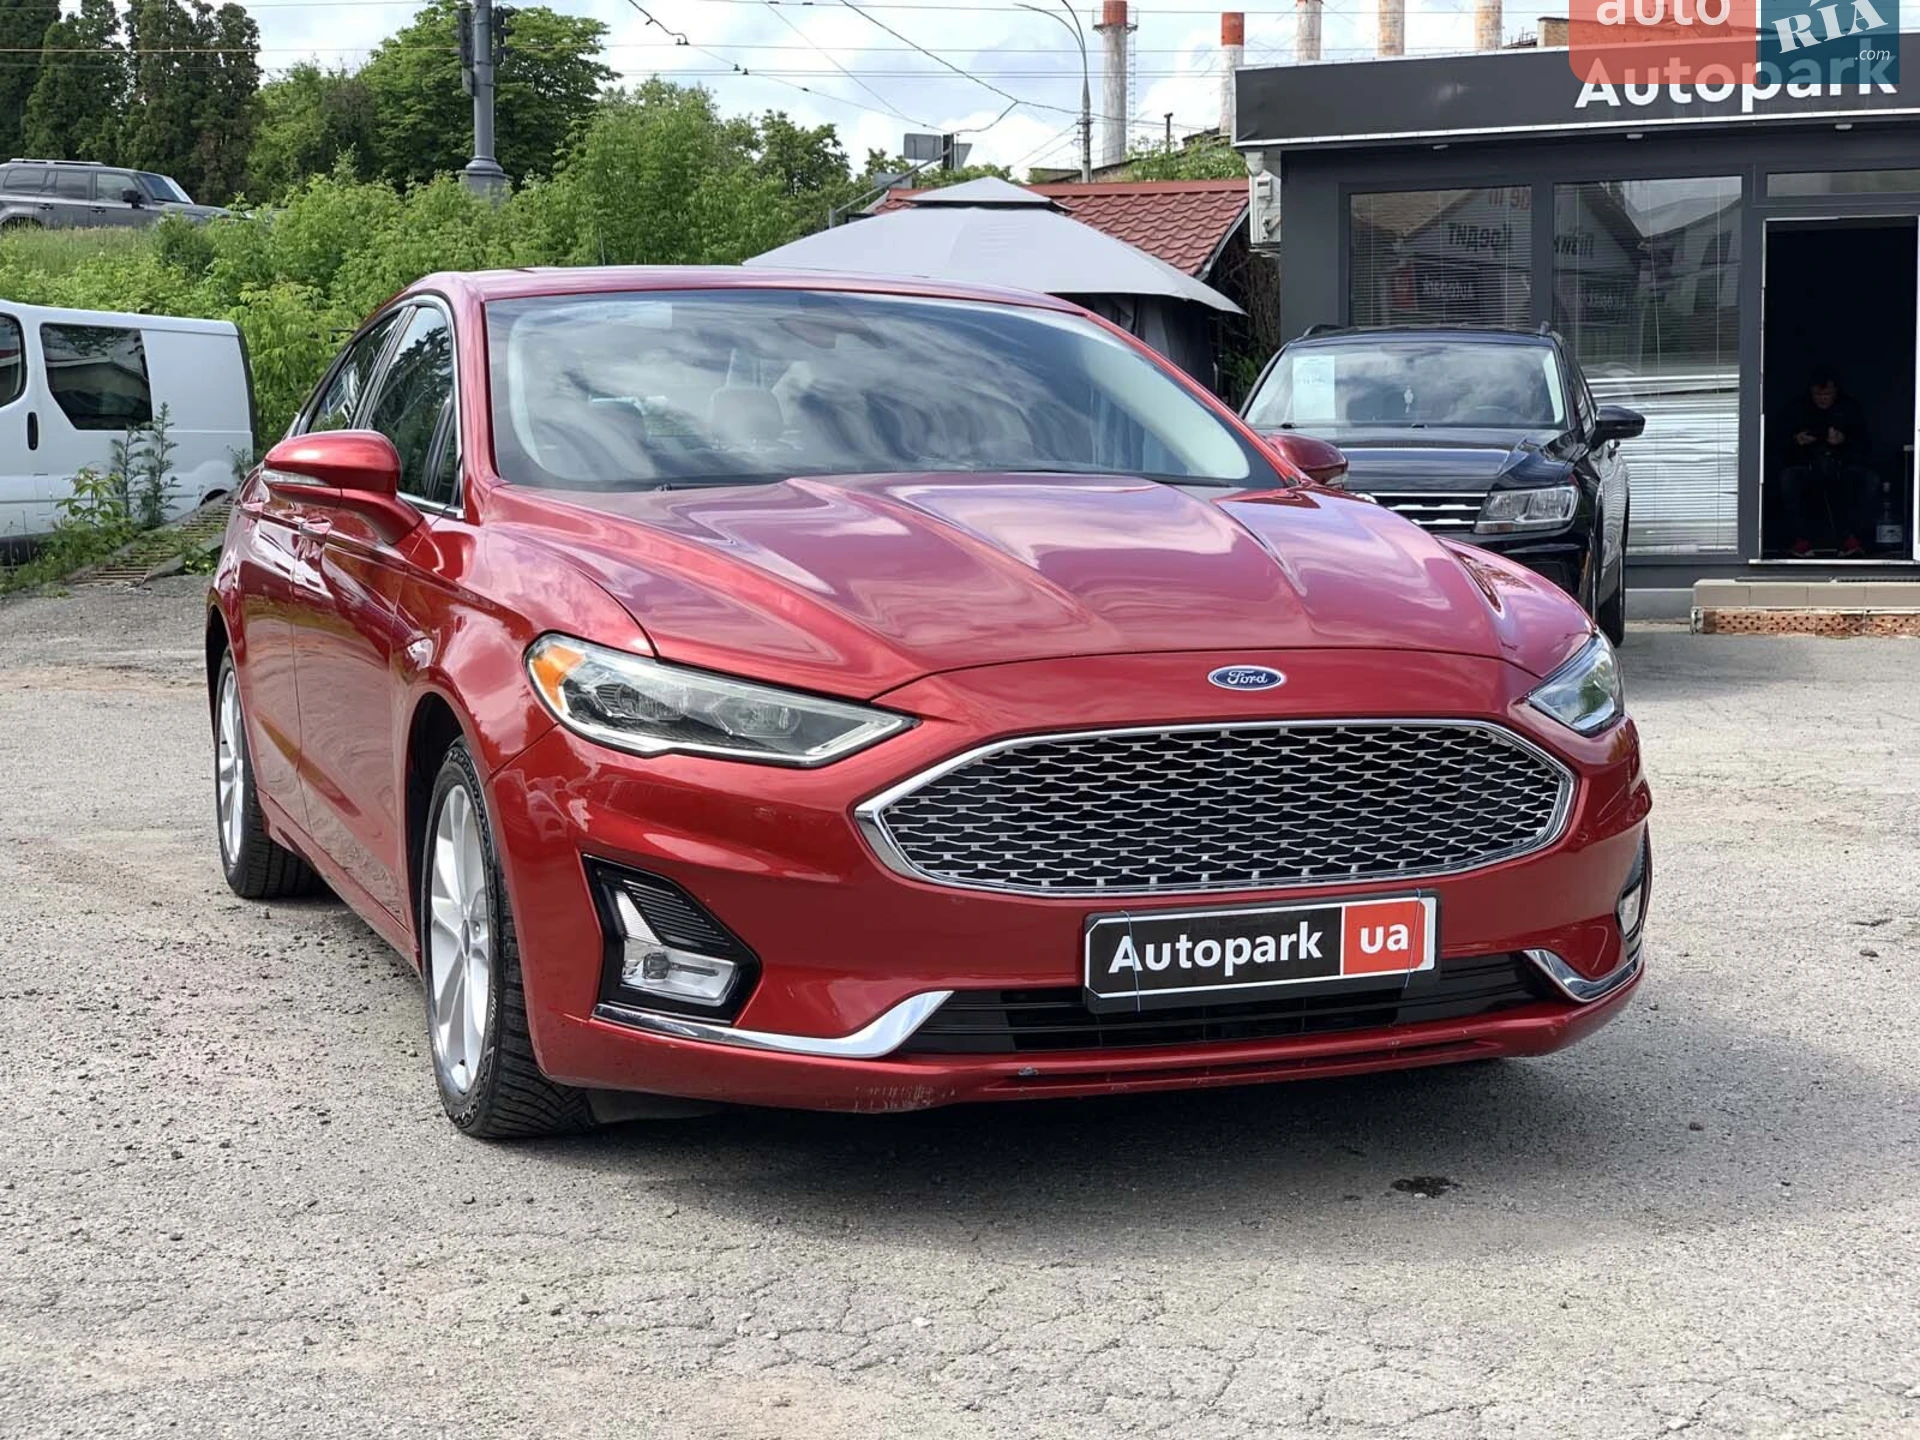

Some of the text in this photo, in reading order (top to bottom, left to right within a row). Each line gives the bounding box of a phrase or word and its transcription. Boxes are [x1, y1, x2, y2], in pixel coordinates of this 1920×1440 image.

[1574, 38, 1898, 113] Autopark
[1227, 670, 1268, 684] Ford
[1108, 920, 1409, 977] Autopark ua
